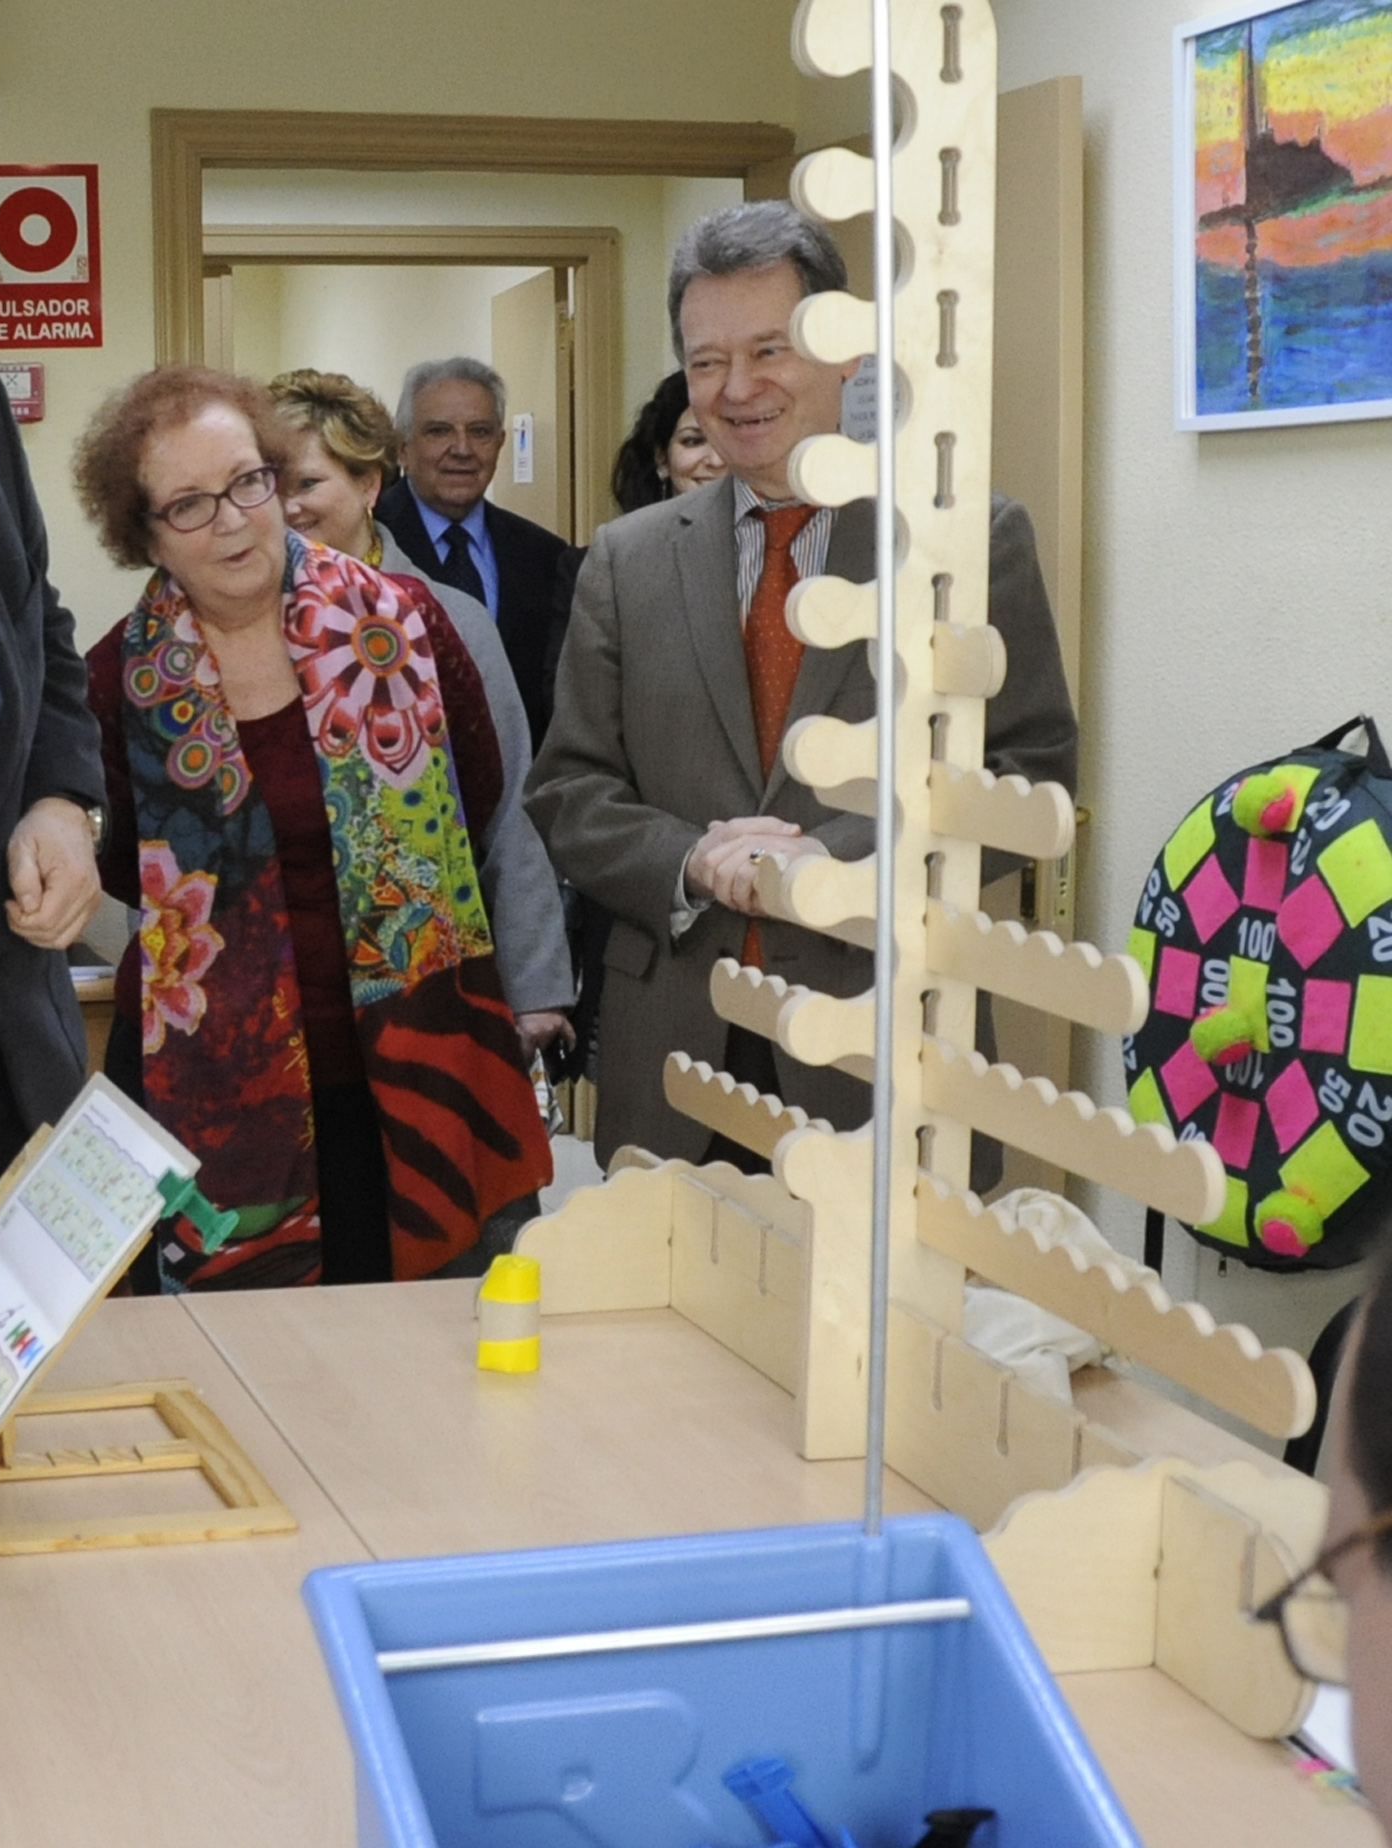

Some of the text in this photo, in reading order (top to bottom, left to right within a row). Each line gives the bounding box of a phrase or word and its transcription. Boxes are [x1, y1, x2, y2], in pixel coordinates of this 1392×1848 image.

[13, 322, 94, 340] ALARMA
[1306, 787, 1351, 831] 20
[1155, 897, 1181, 937] 50
[1238, 917, 1276, 960] 100
[1200, 959, 1230, 1015] 00
[1267, 978, 1297, 1047] 100
[1318, 1067, 1352, 1113] 50
[1346, 1081, 1392, 1147] 20
